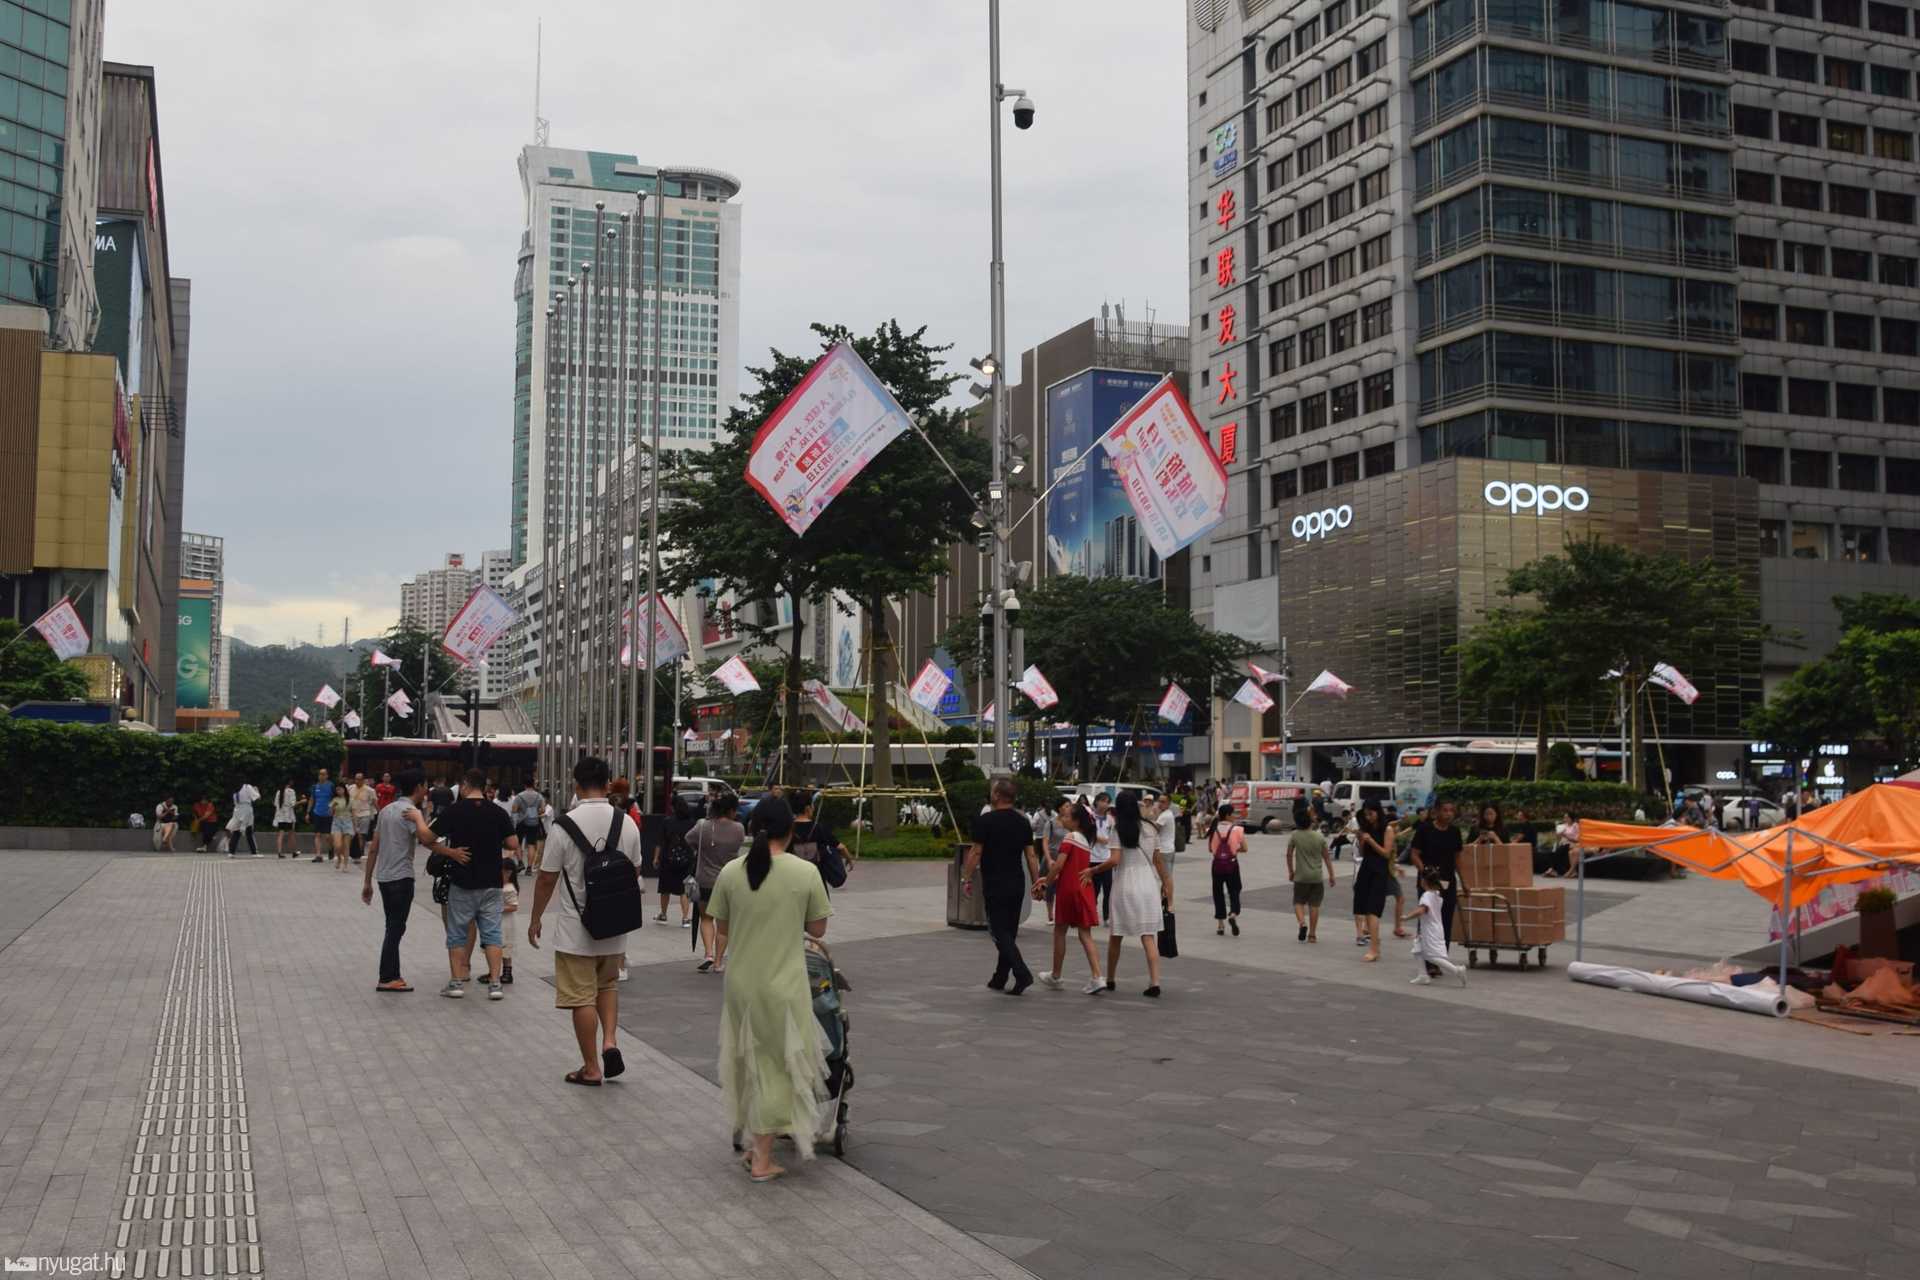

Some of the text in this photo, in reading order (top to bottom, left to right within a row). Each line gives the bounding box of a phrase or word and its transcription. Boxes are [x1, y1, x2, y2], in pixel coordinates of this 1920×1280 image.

[1216, 189, 1238, 465] 华联发大厦
[1484, 480, 1590, 516] oppo
[1291, 504, 1353, 542] oppo
